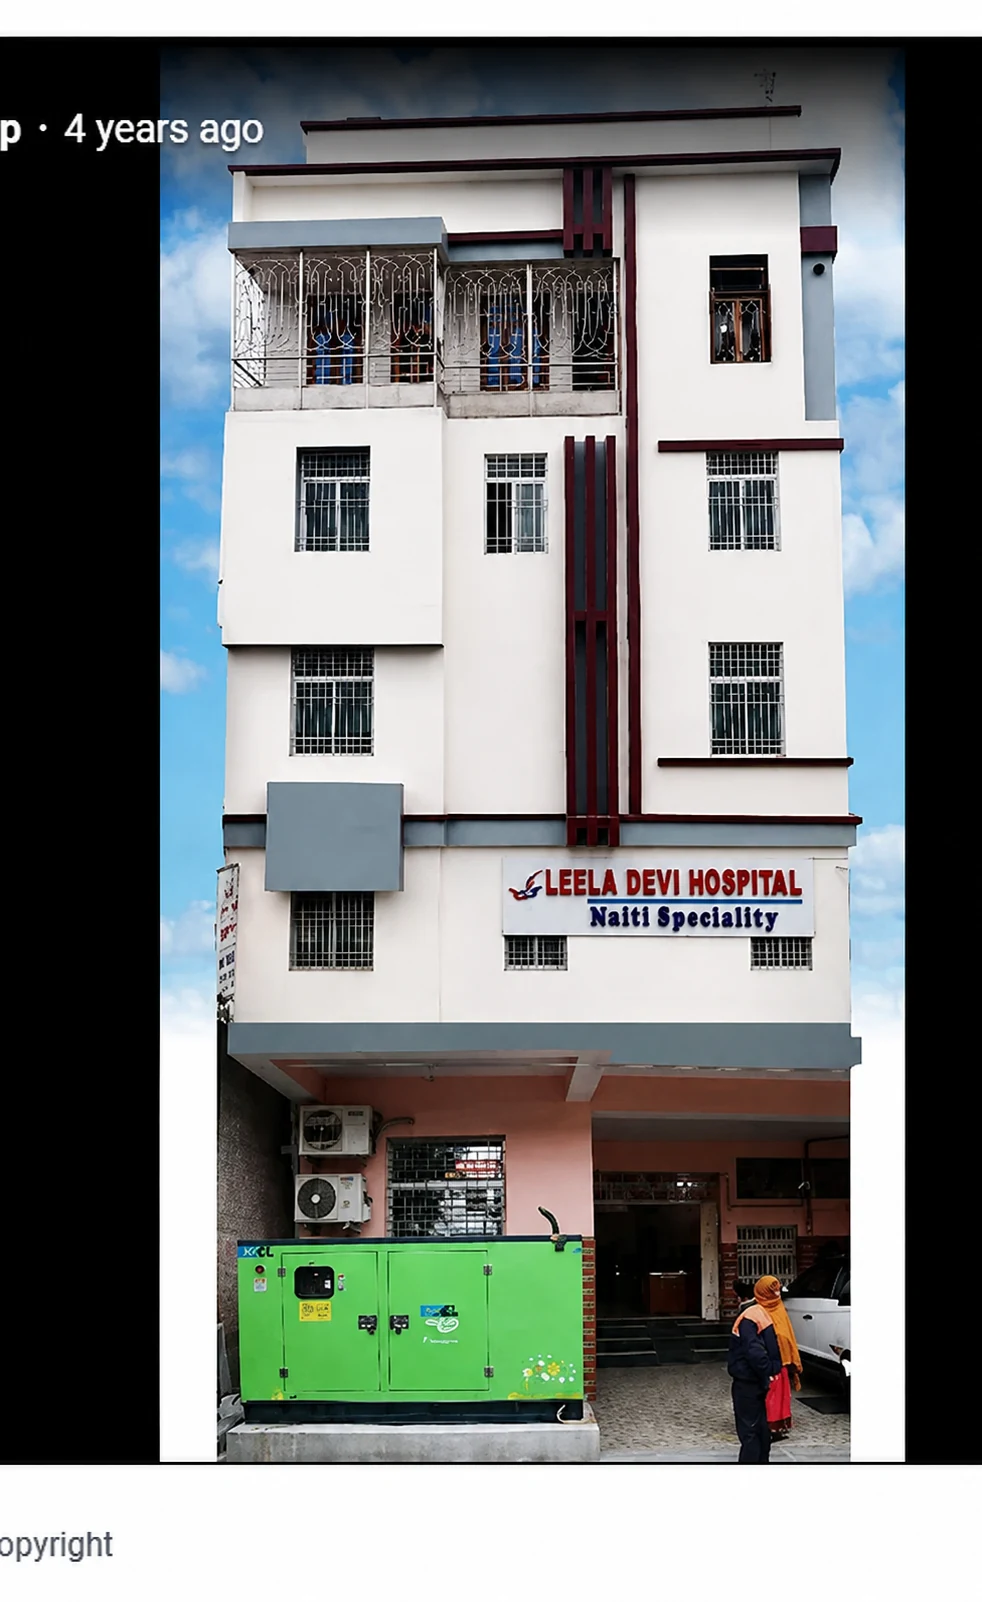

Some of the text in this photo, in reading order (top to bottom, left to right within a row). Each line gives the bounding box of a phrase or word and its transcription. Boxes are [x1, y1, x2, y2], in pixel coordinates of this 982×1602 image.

[545, 868, 803, 896] LEELA DEVI HOSPITAL
[589, 905, 779, 932] Naiti Speciality
